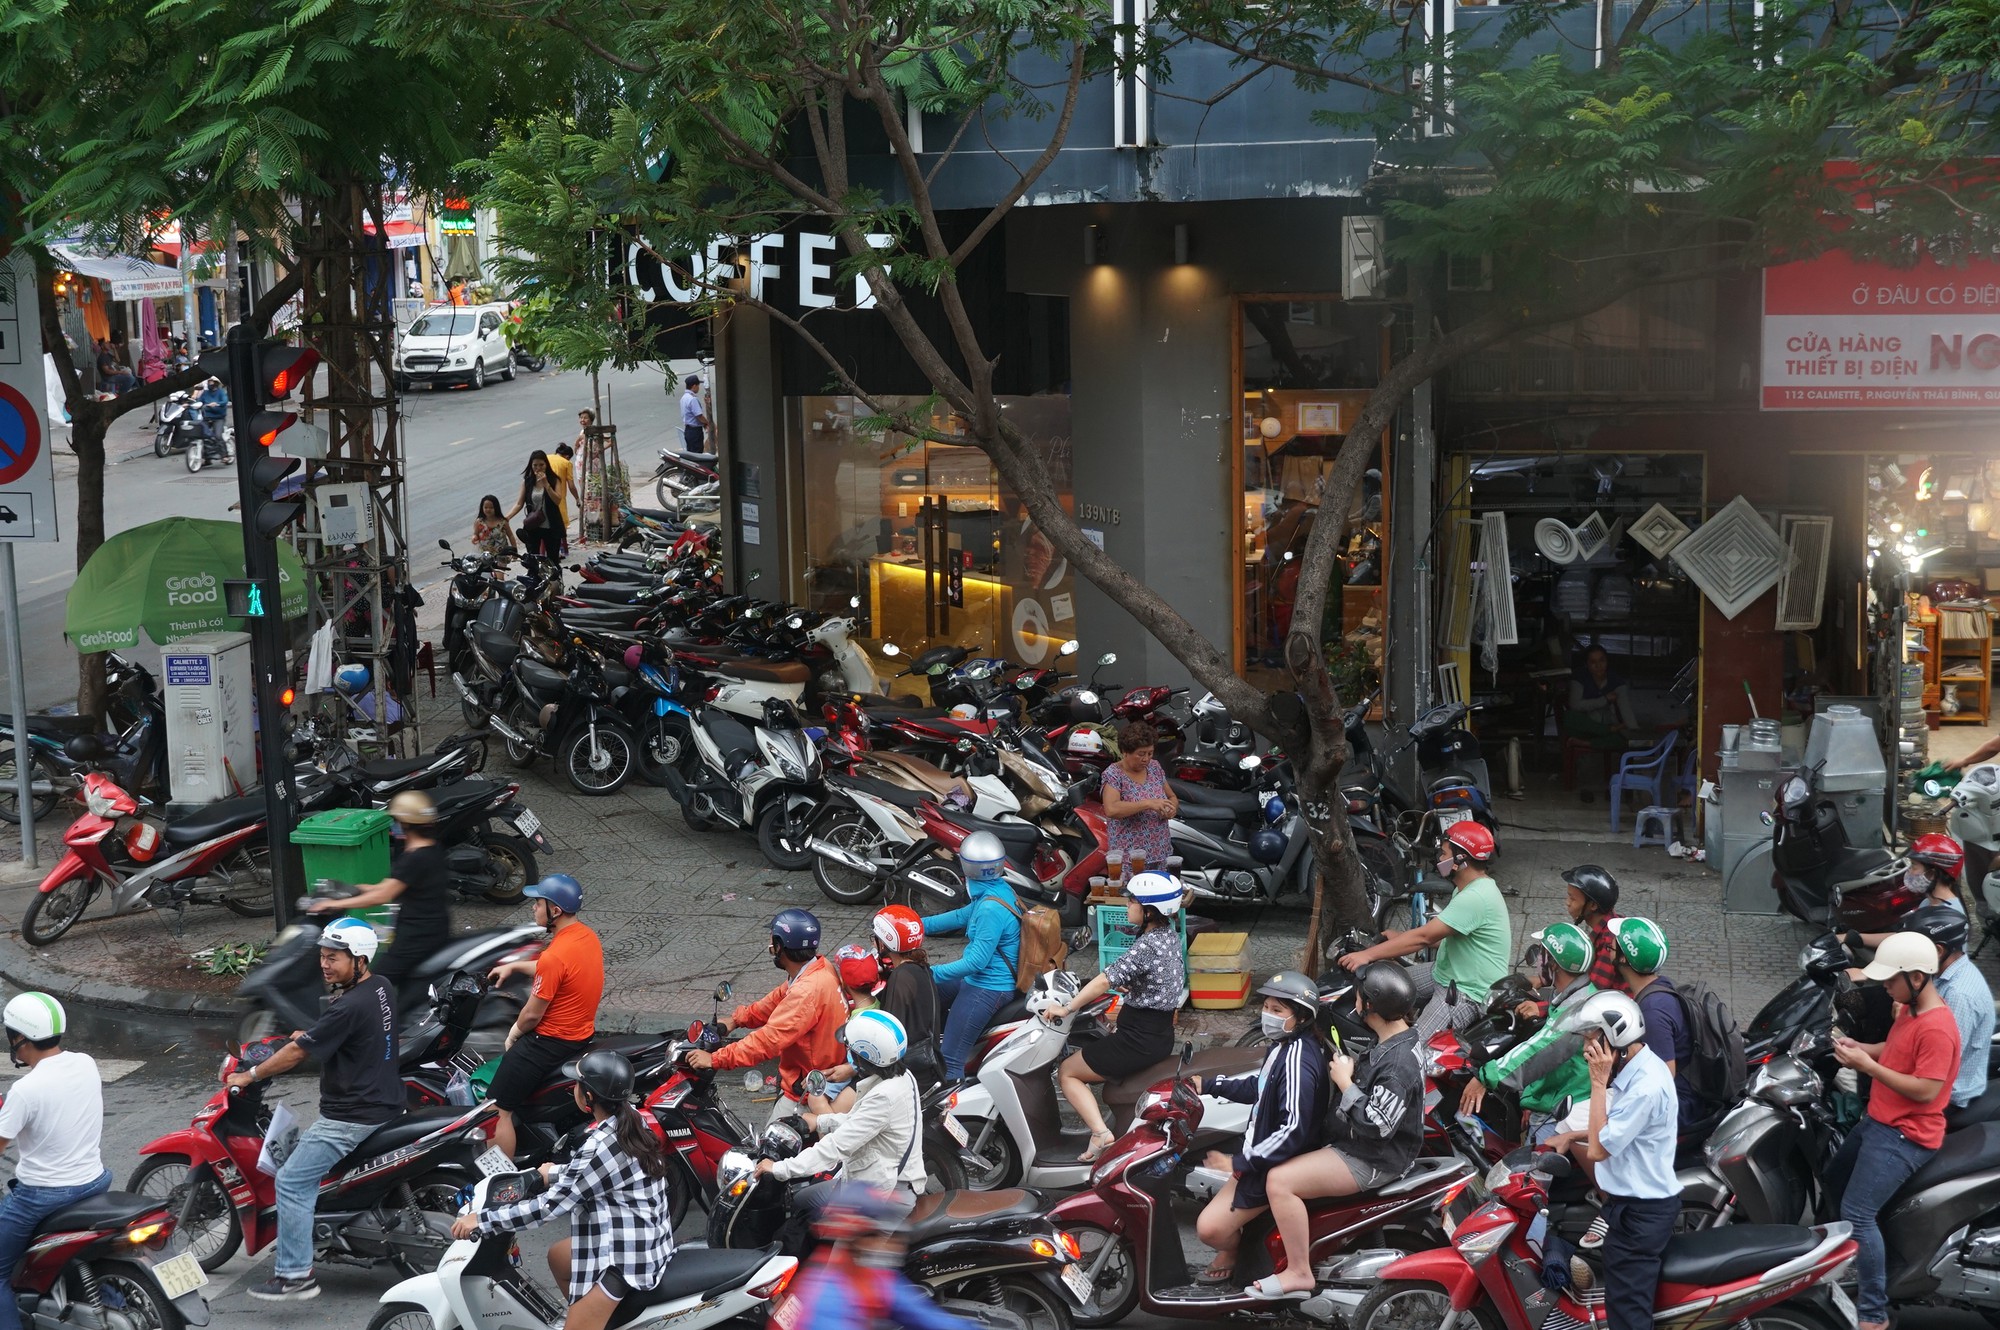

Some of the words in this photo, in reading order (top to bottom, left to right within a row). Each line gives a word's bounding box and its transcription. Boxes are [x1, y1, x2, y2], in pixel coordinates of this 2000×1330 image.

[1876, 284, 1919, 305] ĐÂU
[1926, 282, 1956, 305] CÓ
[1786, 331, 1832, 353] CỬA
[1839, 333, 1902, 353] HÀNG
[1785, 354, 1838, 376] THIẾT
[1844, 360, 1863, 380] BỊ
[1870, 357, 1918, 380] ĐIỆN
[1785, 390, 1804, 400] 112
[1807, 390, 1863, 401] CALMETTE,
[1923, 389, 1949, 400] THÁI
[1080, 503, 1121, 525] 139NTB
[166, 572, 216, 591] Grab
[168, 586, 218, 606] Food
[169, 621, 198, 631] Thèm
[80, 628, 134, 647] GrabFood
[1306, 802, 1330, 820] 32
[1547, 934, 1564, 954] Grab
[1622, 934, 1638, 956] Grab
[666, 1127, 692, 1138] YAMAHA
[1360, 1198, 1410, 1215] VISION
[158, 1256, 193, 1280] 54-L6
[168, 1270, 202, 1295] 1783
[1526, 1302, 1550, 1310] HONDA
